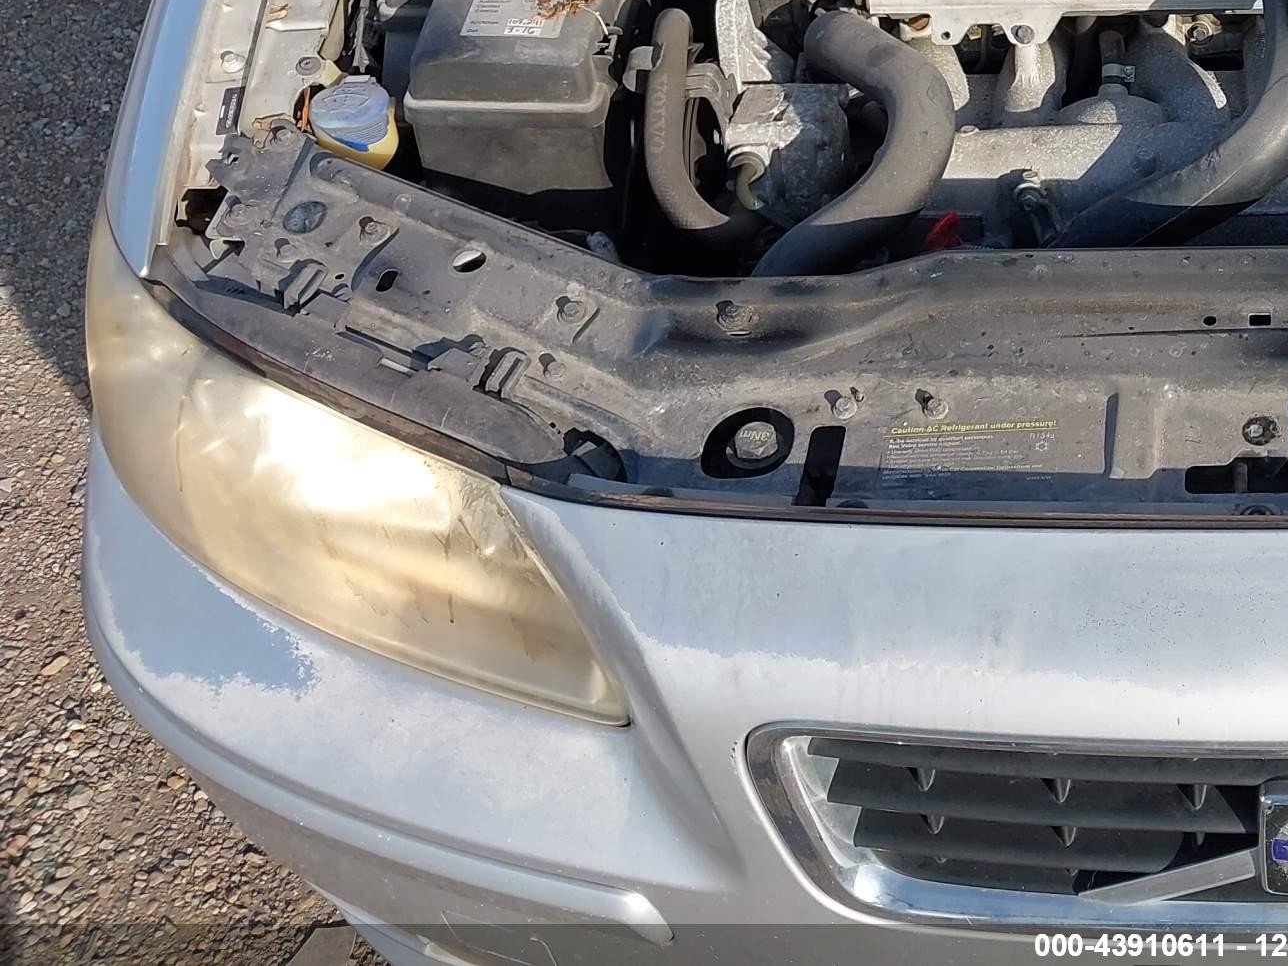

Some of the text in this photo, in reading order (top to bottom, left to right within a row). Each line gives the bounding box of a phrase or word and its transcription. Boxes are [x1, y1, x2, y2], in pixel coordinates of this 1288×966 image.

[891, 419, 1057, 434] Caution AC Refrigerant under pressure!
